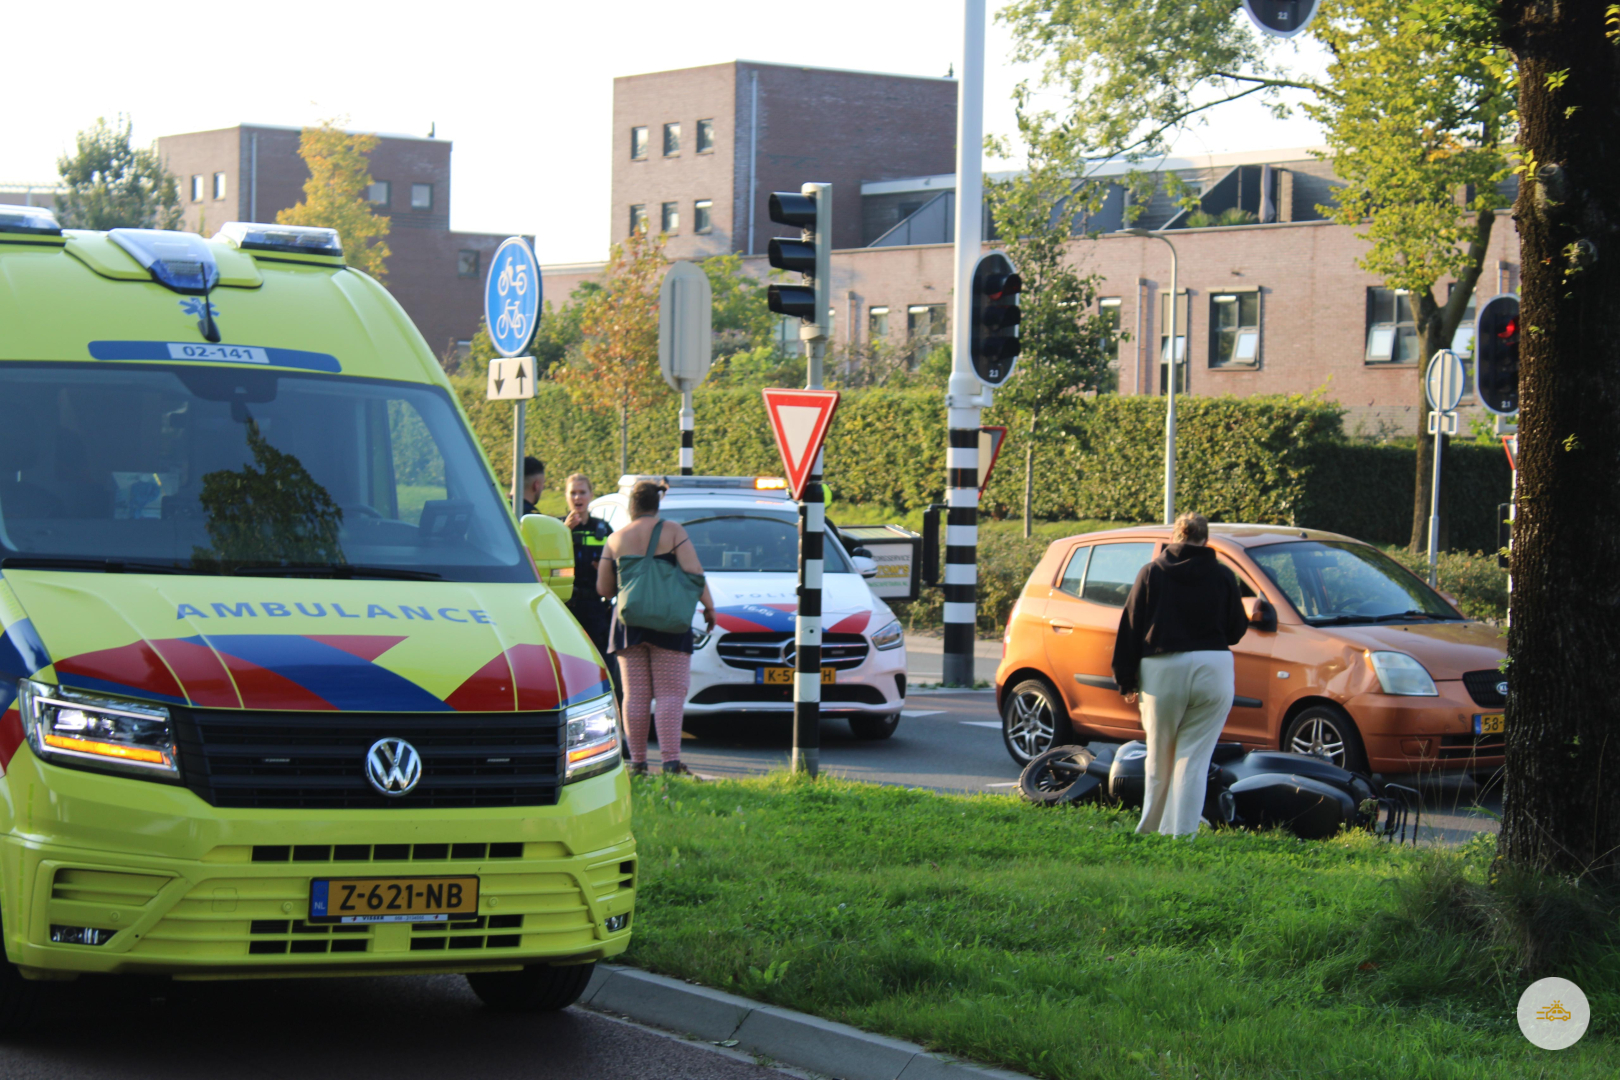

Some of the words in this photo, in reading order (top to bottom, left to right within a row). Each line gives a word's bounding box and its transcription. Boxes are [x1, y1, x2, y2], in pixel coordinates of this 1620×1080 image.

[182, 346, 254, 360] 02-141
[176, 602, 497, 625] AMBULANCE
[314, 902, 326, 910] NL
[339, 883, 463, 911] Z-621-NB
